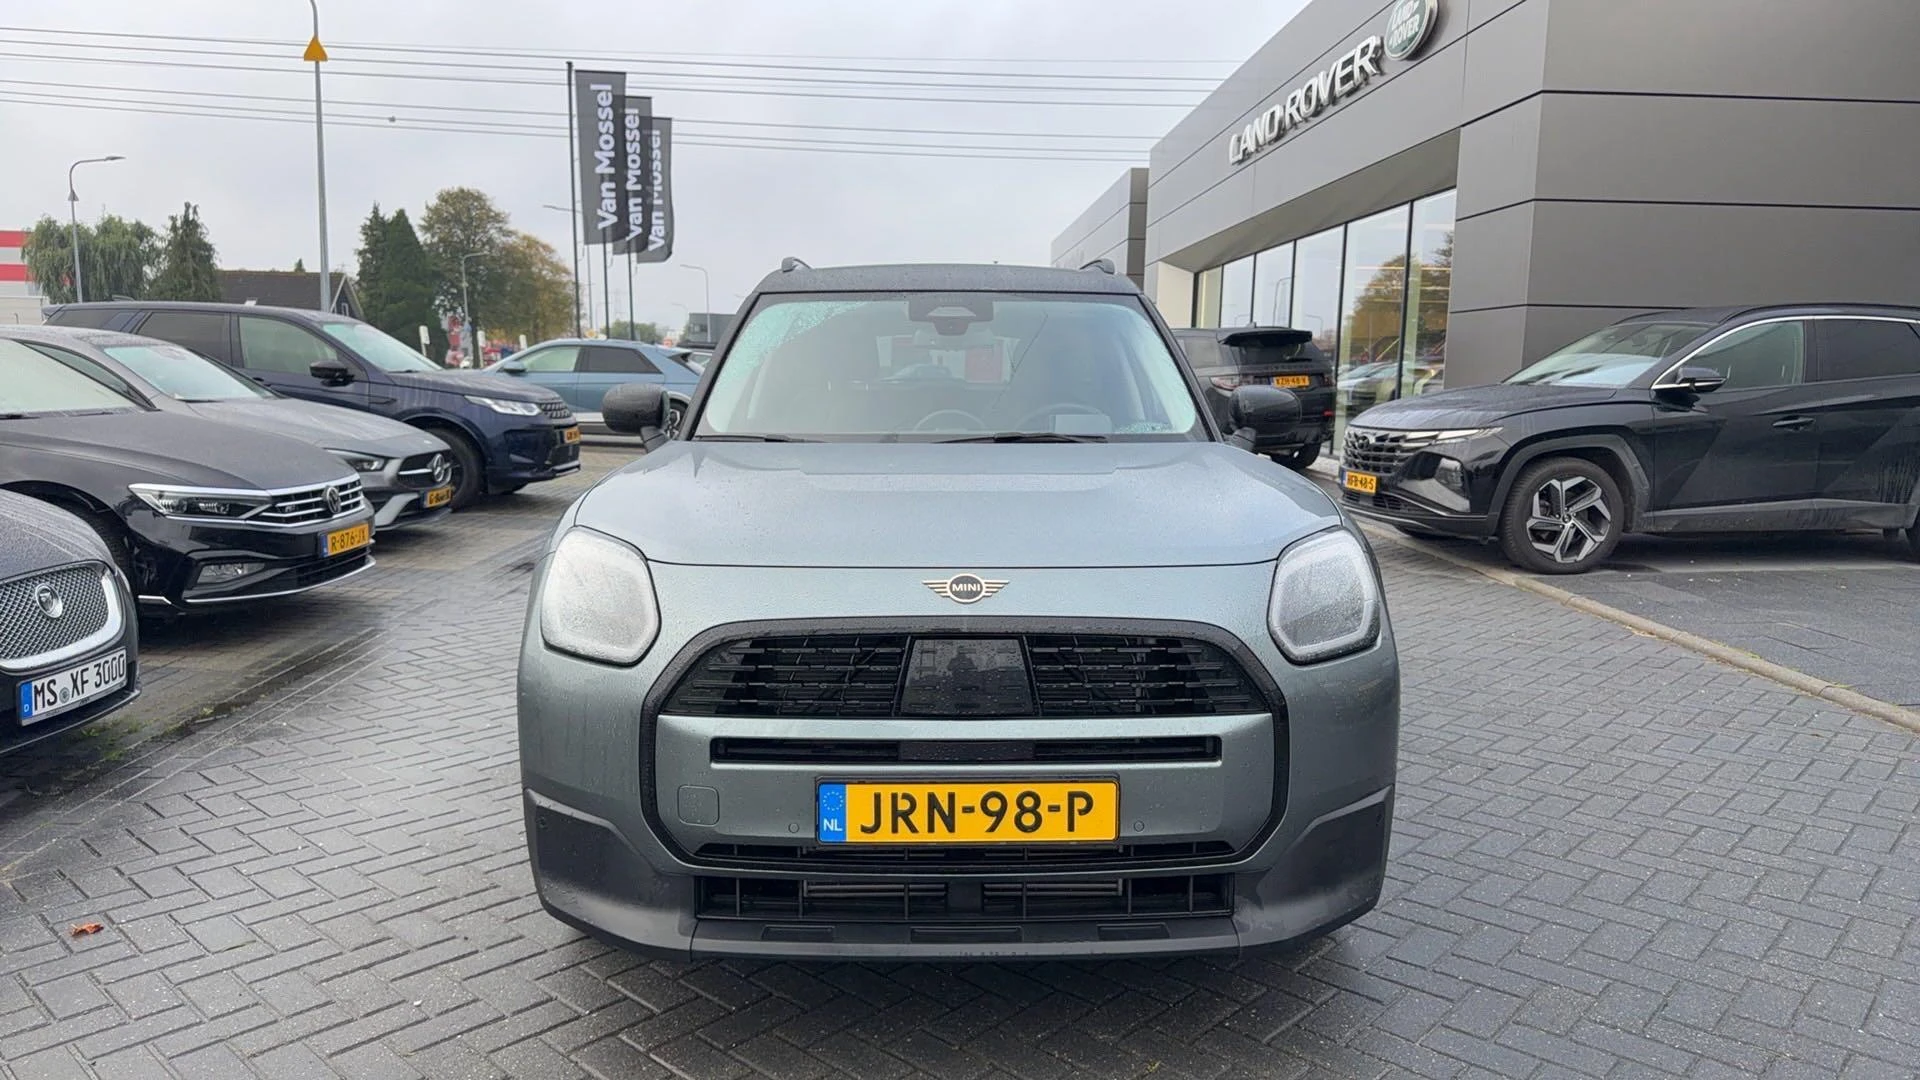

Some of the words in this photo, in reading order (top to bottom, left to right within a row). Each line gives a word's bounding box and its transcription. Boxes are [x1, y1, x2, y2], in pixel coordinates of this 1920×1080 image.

[1229, 104, 1284, 164] LAND
[1284, 35, 1382, 129] ROVER
[590, 83, 616, 174] Mossel
[625, 108, 642, 190] Mossel
[597, 182, 619, 230] Van
[648, 211, 665, 252] Van
[951, 583, 982, 592] MINI
[33, 678, 58, 711] MS
[70, 667, 89, 698] XF
[93, 653, 125, 689] 3000
[823, 819, 843, 832] NL
[860, 790, 1094, 834] JRN-98-P
